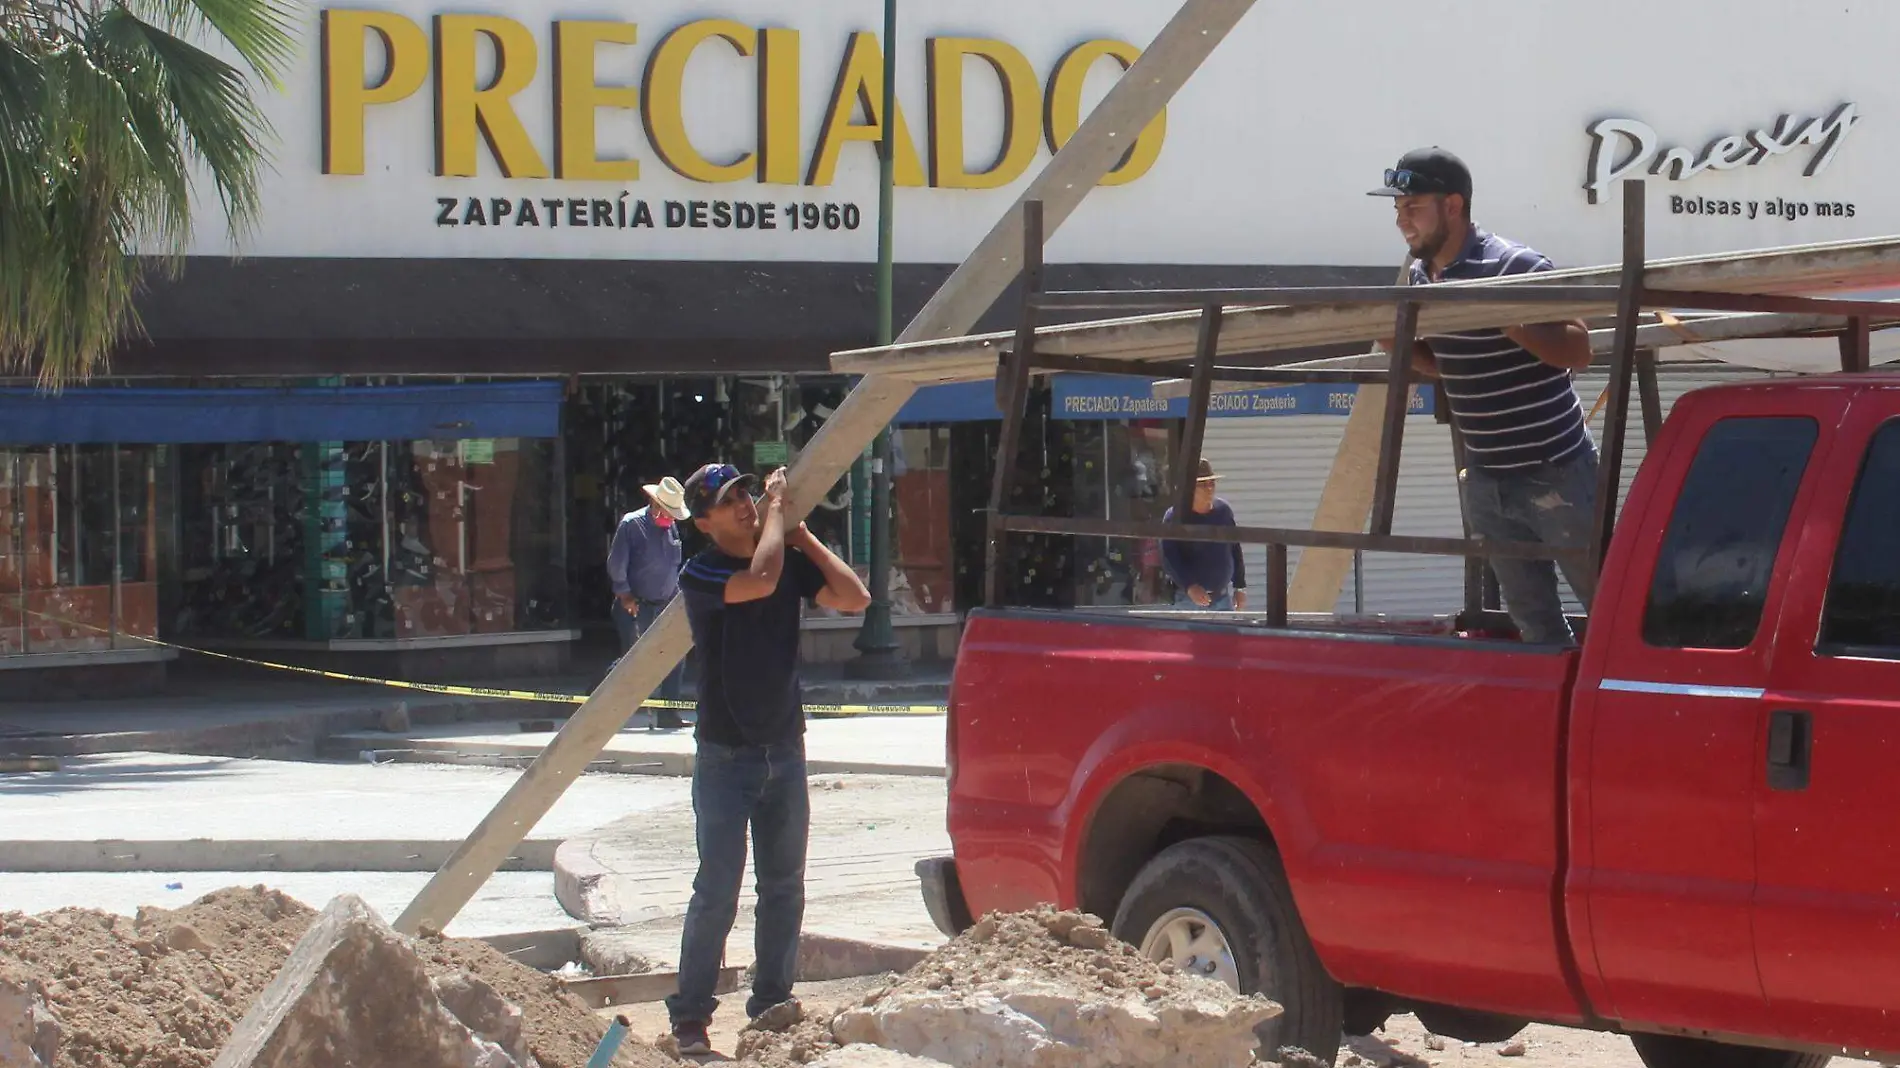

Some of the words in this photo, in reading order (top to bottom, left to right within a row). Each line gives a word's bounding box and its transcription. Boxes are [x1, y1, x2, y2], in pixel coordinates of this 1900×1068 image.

[321, 8, 1168, 190] PRECIADO
[437, 190, 655, 229] ZAPATERÍA
[666, 200, 777, 229] DESDE
[785, 202, 861, 230] 1960
[1670, 196, 1741, 216] Bolsas
[1747, 200, 1759, 219] y
[1765, 197, 1809, 221] algo
[1816, 202, 1856, 218] mas
[1064, 396, 1119, 413] PRECIADO
[1207, 394, 1249, 411] ECIADO
